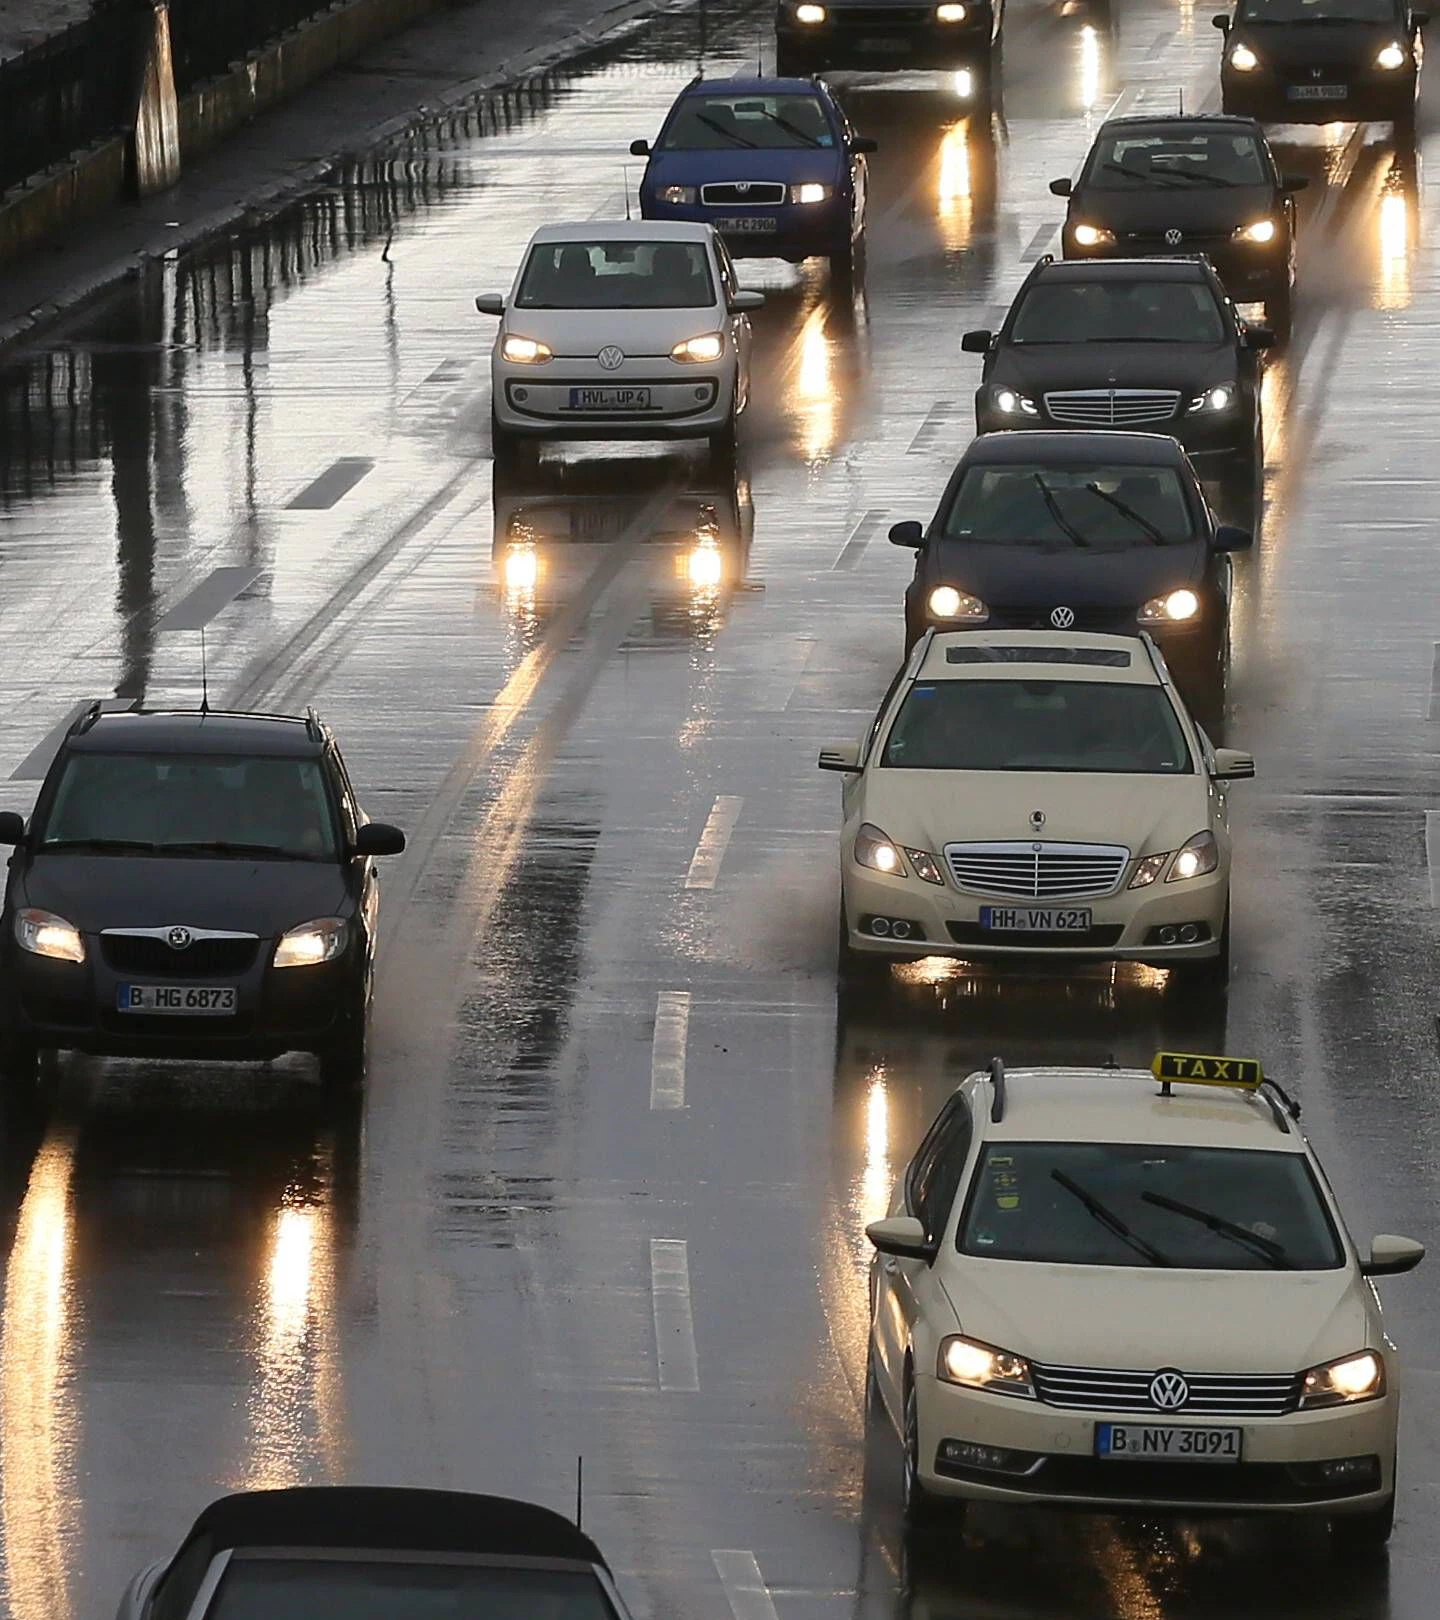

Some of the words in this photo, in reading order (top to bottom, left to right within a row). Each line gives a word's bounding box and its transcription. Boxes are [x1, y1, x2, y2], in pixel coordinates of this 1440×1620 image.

[582, 391, 608, 404] HVL
[617, 391, 634, 404] UP
[637, 391, 645, 404] 4
[992, 909, 1016, 927] HH
[1028, 910, 1053, 928] VN
[1059, 911, 1089, 929] 621
[131, 988, 143, 1007] B
[156, 988, 182, 1007] HG
[186, 988, 234, 1008] 6873
[1172, 1057, 1245, 1081] TAXI
[1112, 1428, 1127, 1449] B
[1142, 1429, 1175, 1451] NY
[1179, 1431, 1237, 1455] 3091
